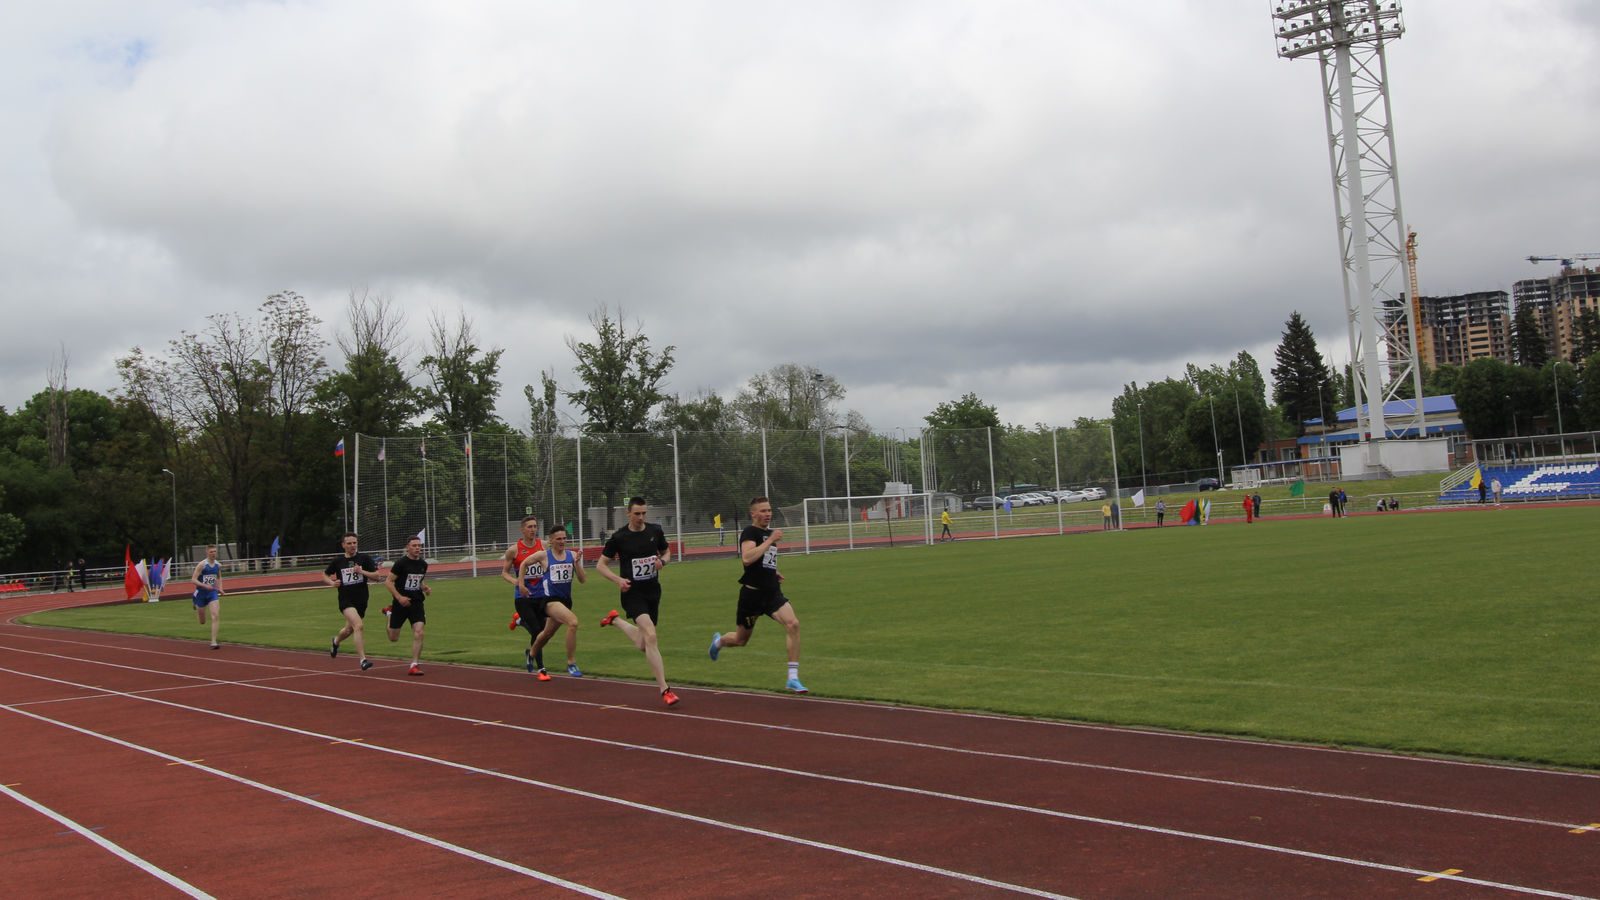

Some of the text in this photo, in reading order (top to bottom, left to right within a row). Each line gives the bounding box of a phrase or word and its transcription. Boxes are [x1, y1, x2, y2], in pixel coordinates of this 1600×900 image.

[525, 565, 542, 576] 200
[556, 569, 569, 580] 18
[346, 571, 359, 582] 78
[408, 578, 418, 588] 13
